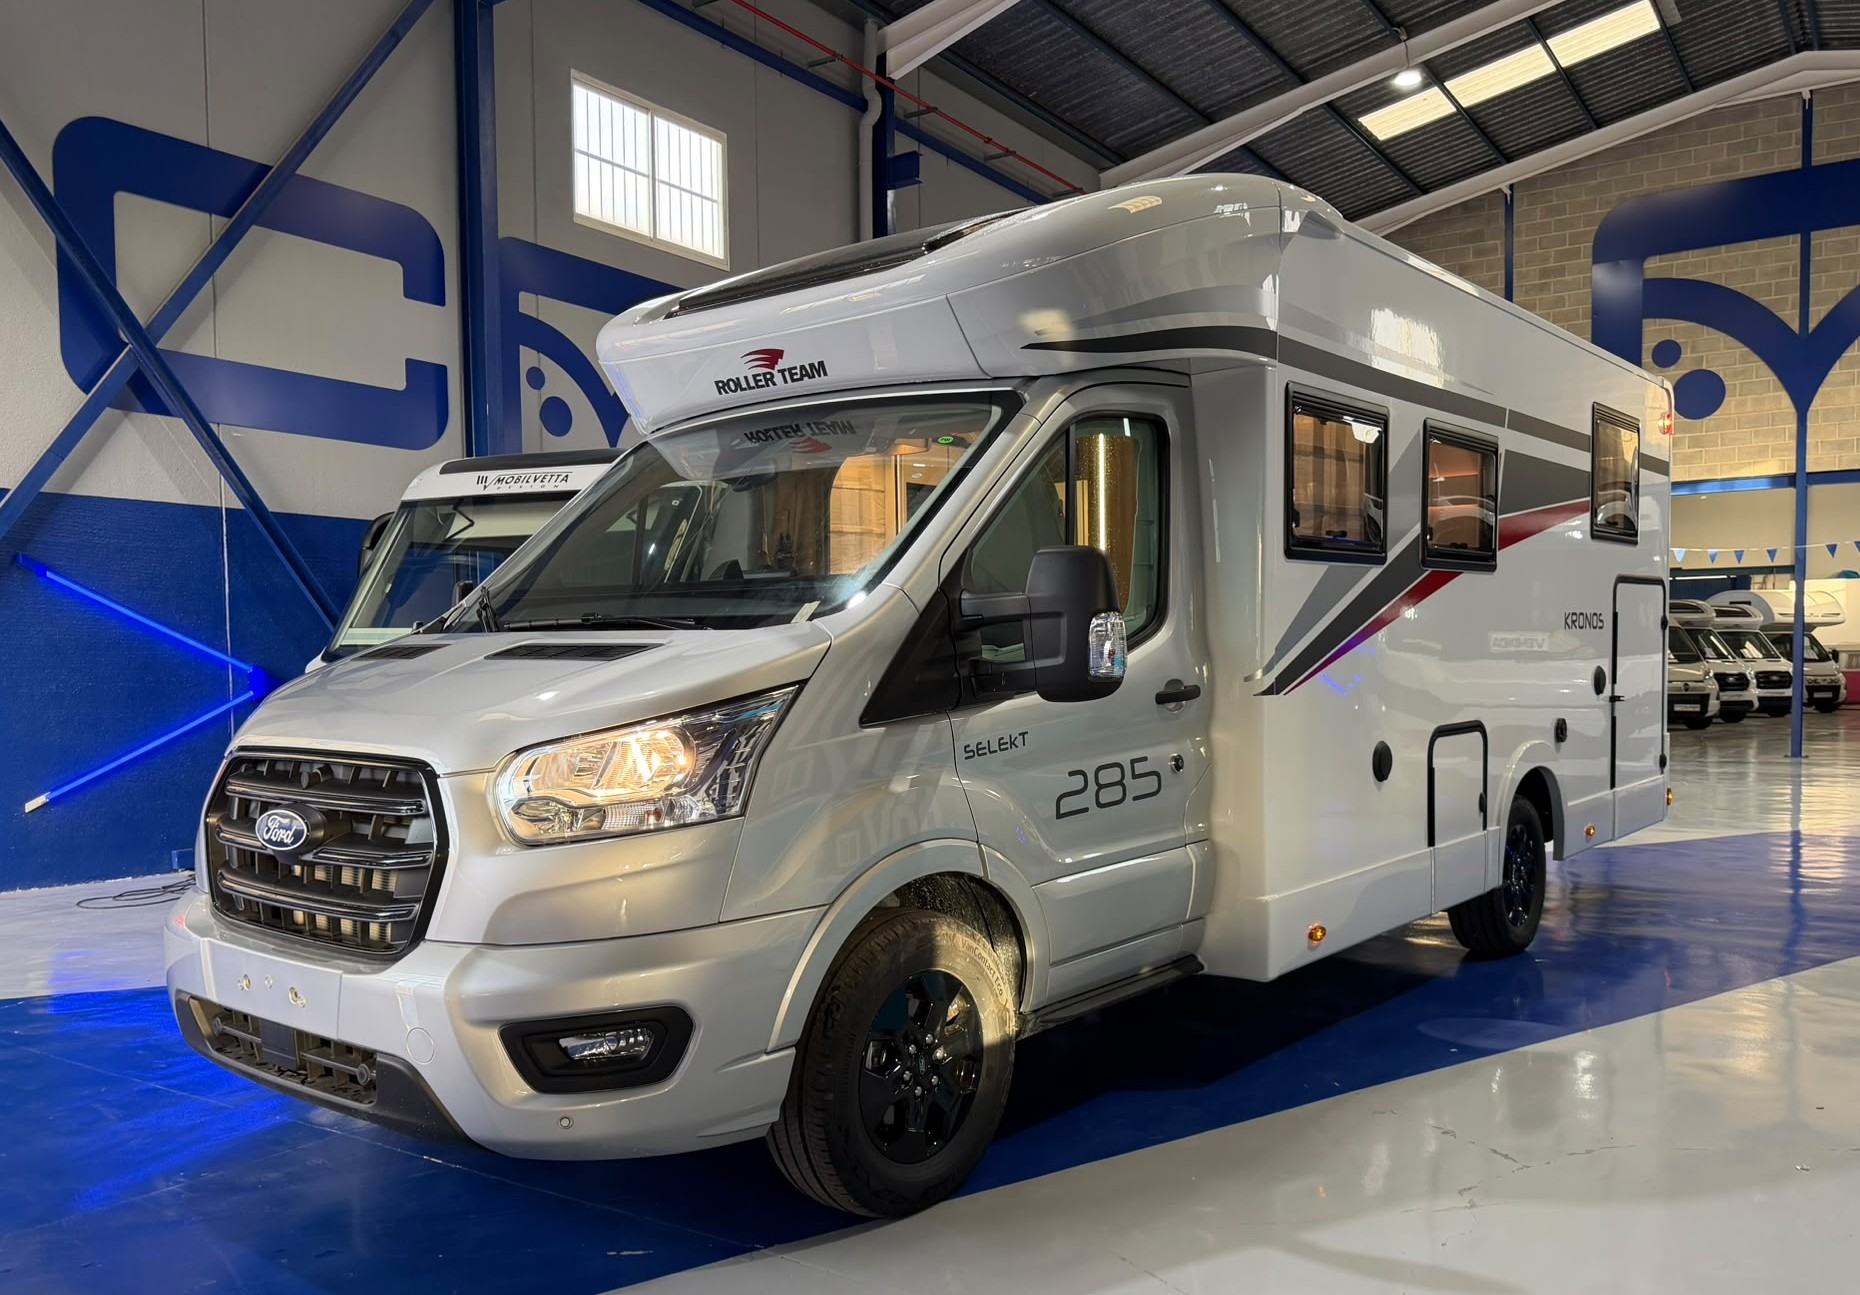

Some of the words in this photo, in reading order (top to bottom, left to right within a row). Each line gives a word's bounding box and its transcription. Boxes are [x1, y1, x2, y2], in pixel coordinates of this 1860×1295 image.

[714, 370, 777, 395] ROLLER
[777, 360, 829, 384] TEAM
[494, 474, 569, 485] MOBILVETTA
[1563, 612, 1604, 630] KRONOS
[964, 731, 1028, 760] SELEKT
[1055, 756, 1162, 820] 285
[263, 815, 296, 844] Ford
[961, 939, 996, 977] VanContact
